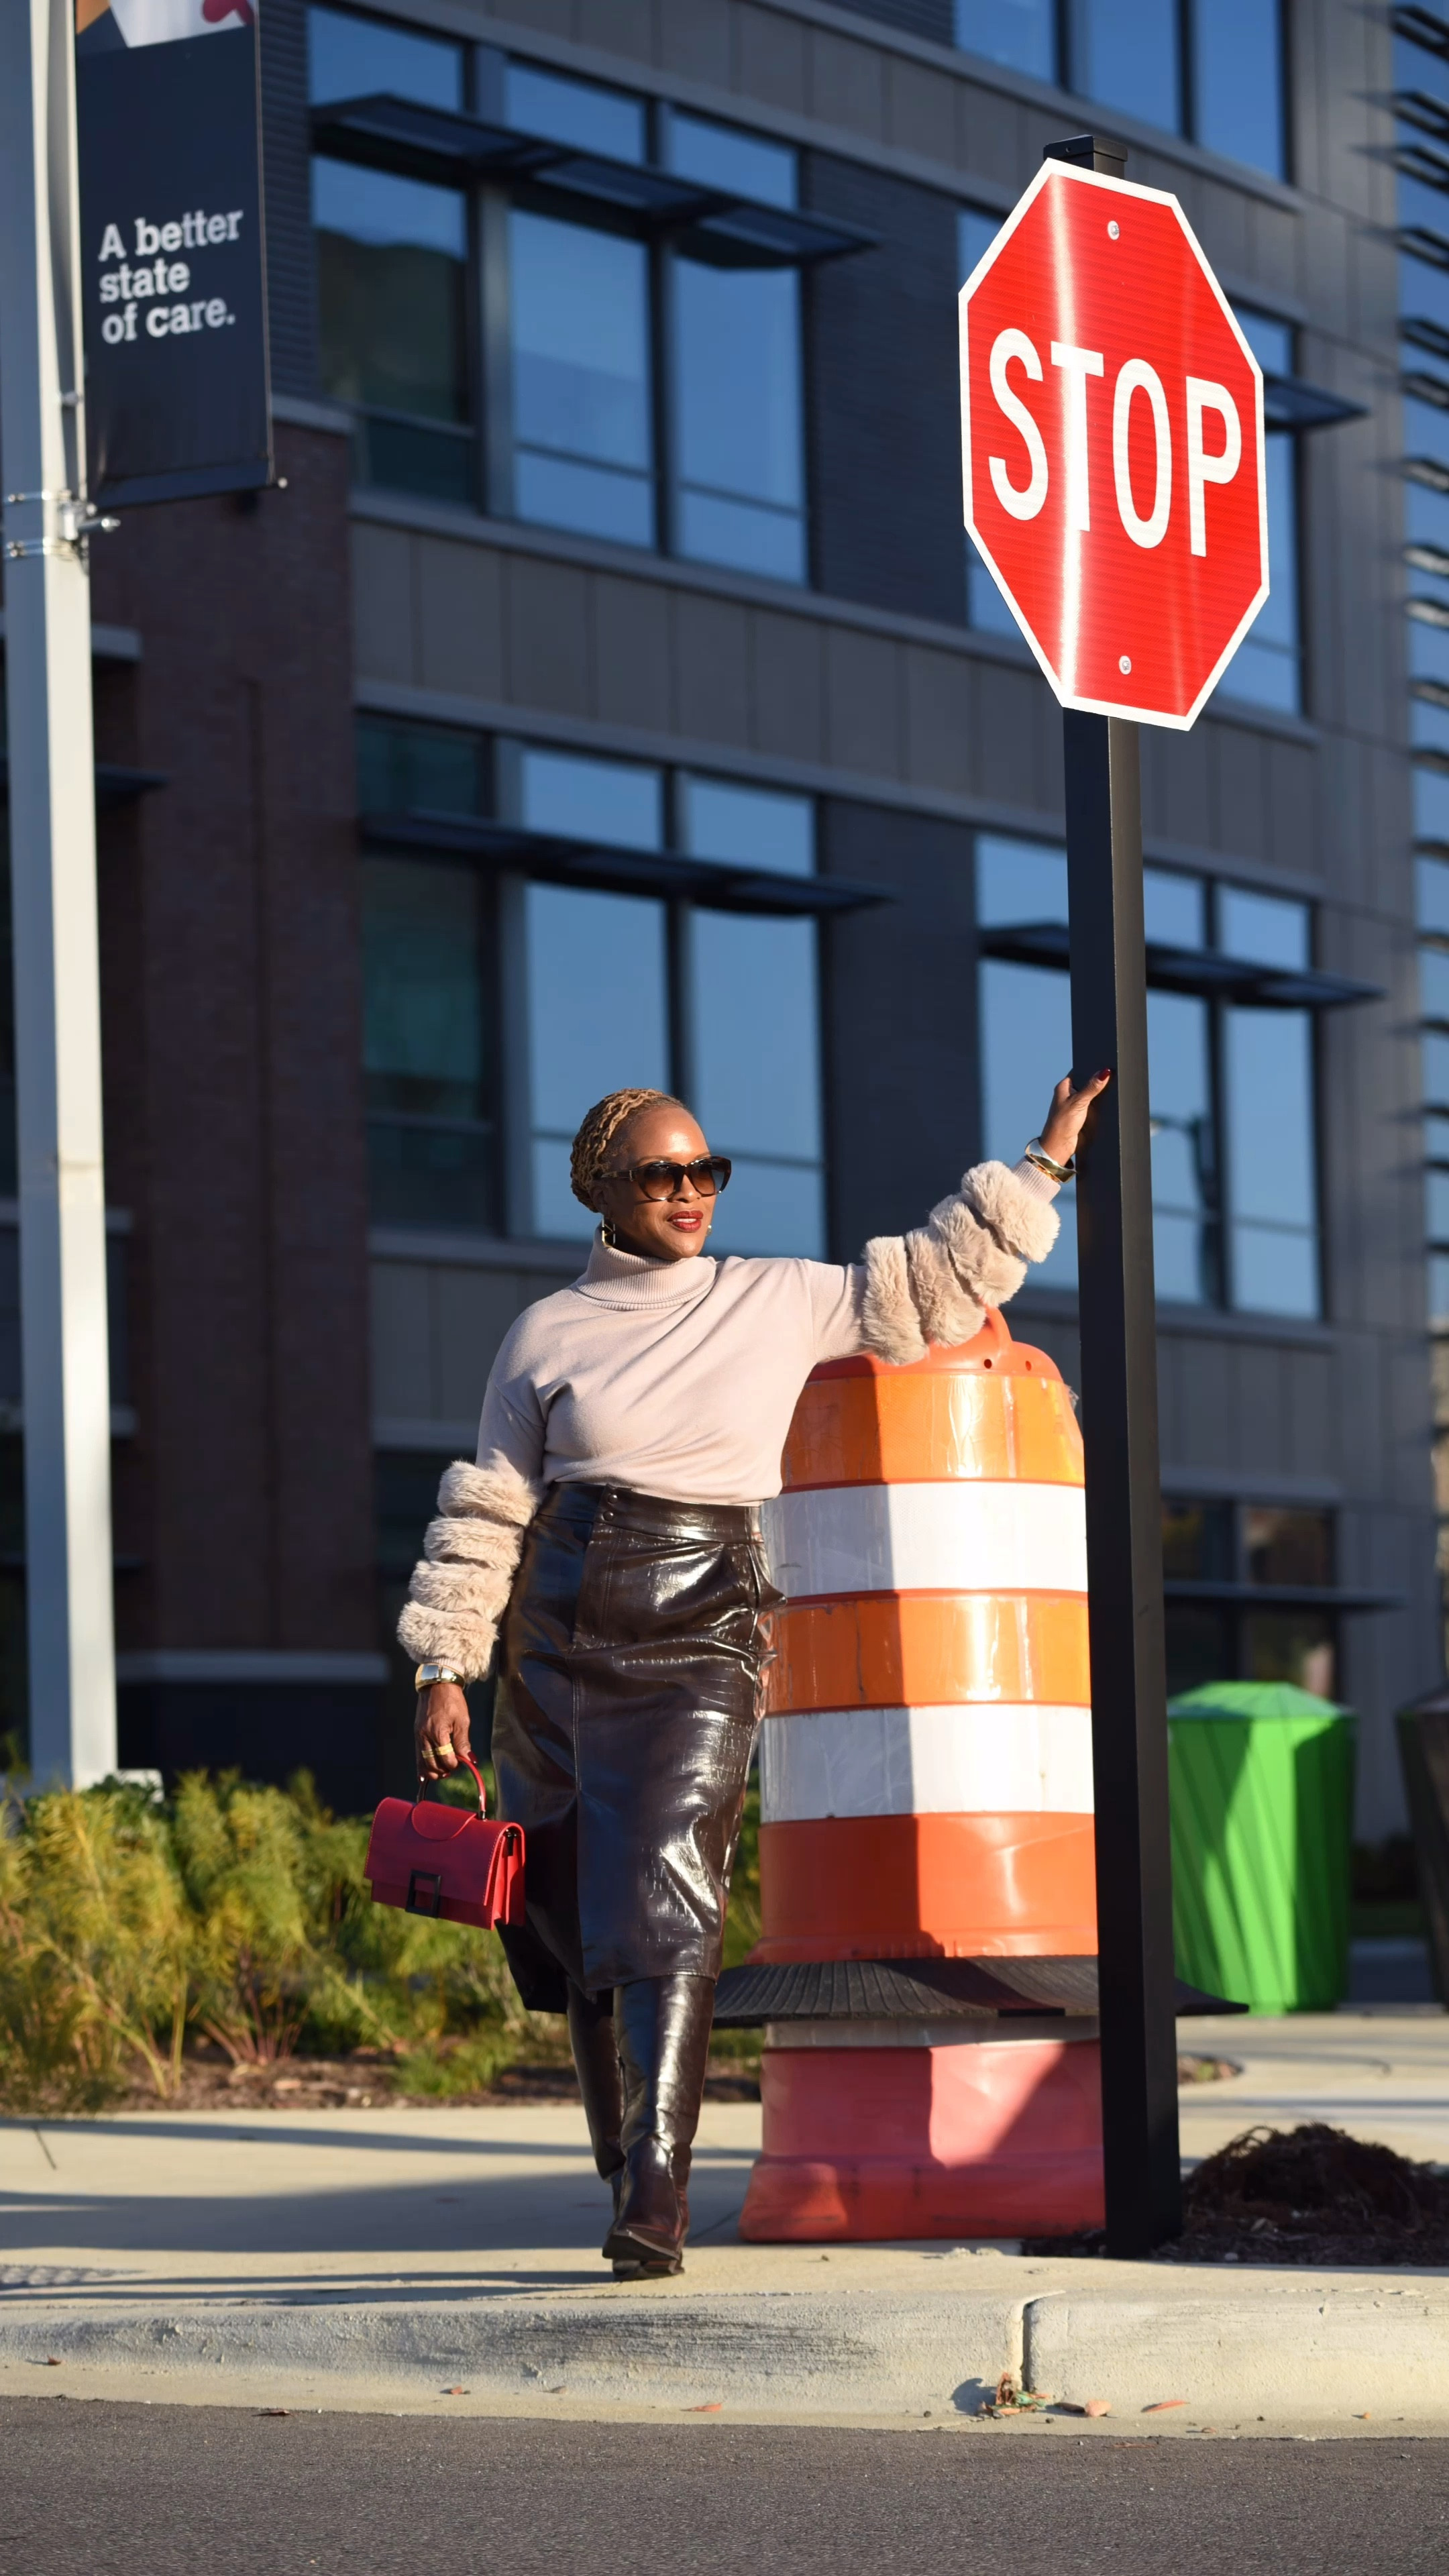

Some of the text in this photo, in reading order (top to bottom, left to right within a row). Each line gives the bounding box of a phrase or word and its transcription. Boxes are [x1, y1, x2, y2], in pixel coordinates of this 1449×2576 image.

[99, 209, 243, 262] A better
[100, 258, 190, 303] state
[102, 298, 235, 343] of care.
[989, 328, 1241, 557] STOP
